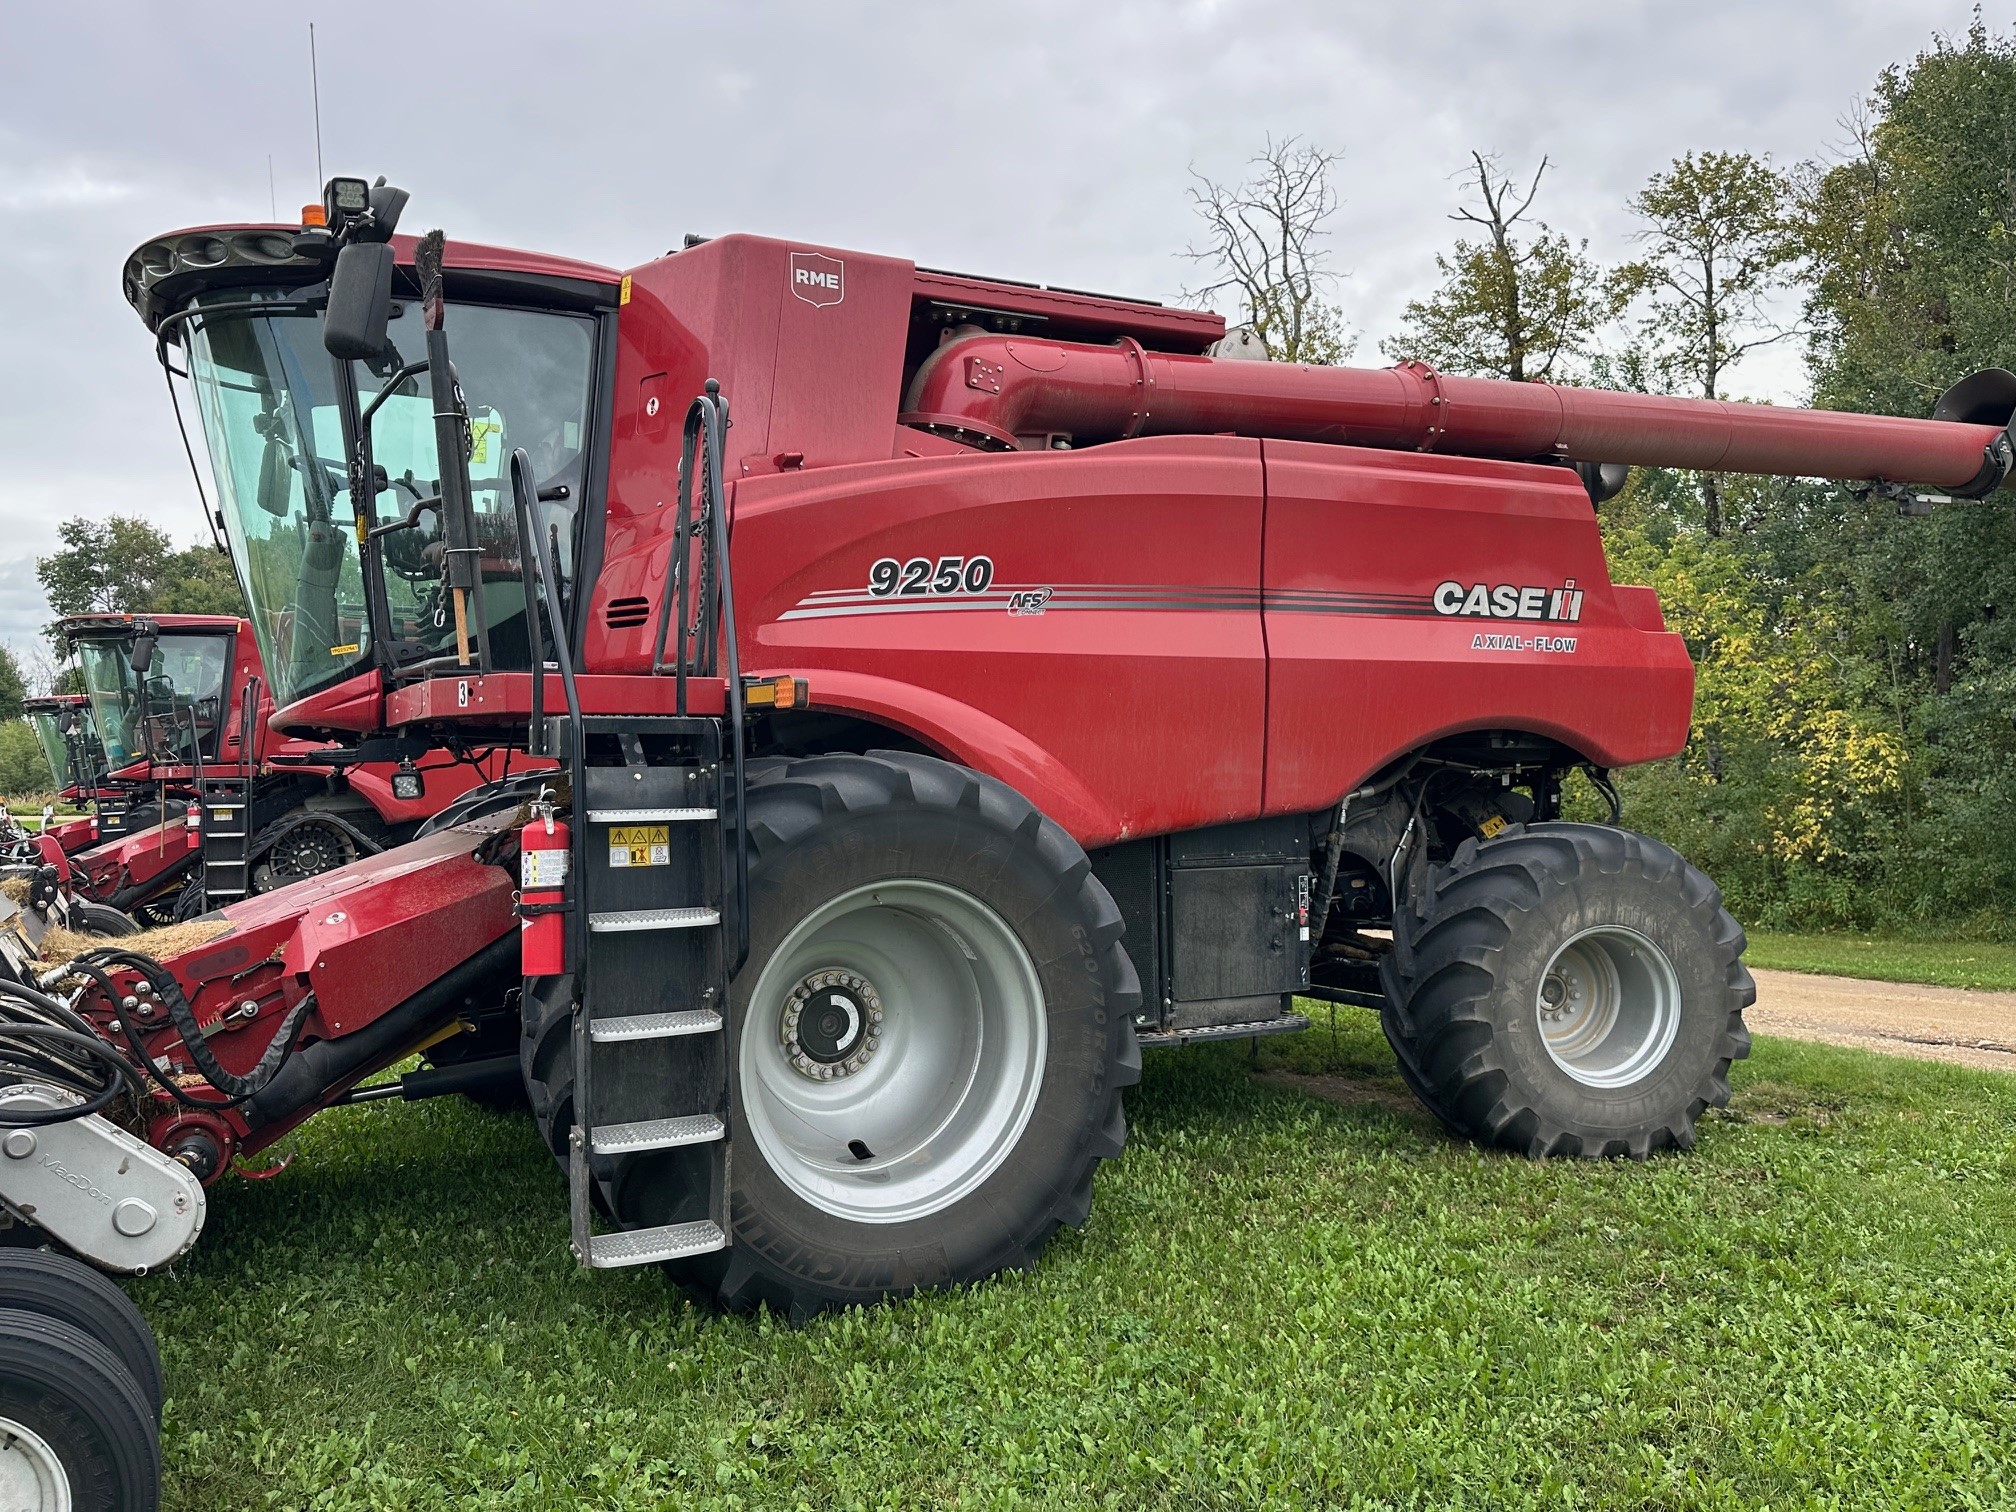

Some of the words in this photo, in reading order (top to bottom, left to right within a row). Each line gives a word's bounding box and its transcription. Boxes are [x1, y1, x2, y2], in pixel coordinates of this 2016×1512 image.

[796, 268, 839, 290] RME
[868, 555, 995, 598] 9250
[1008, 592, 1044, 609] AFS
[1433, 581, 1546, 619] CASE
[1471, 633, 1578, 653] AXIAL-FLOW
[460, 682, 467, 706] 3
[37, 1153, 112, 1206] MacDon
[731, 1190, 896, 1289] MICHELIN
